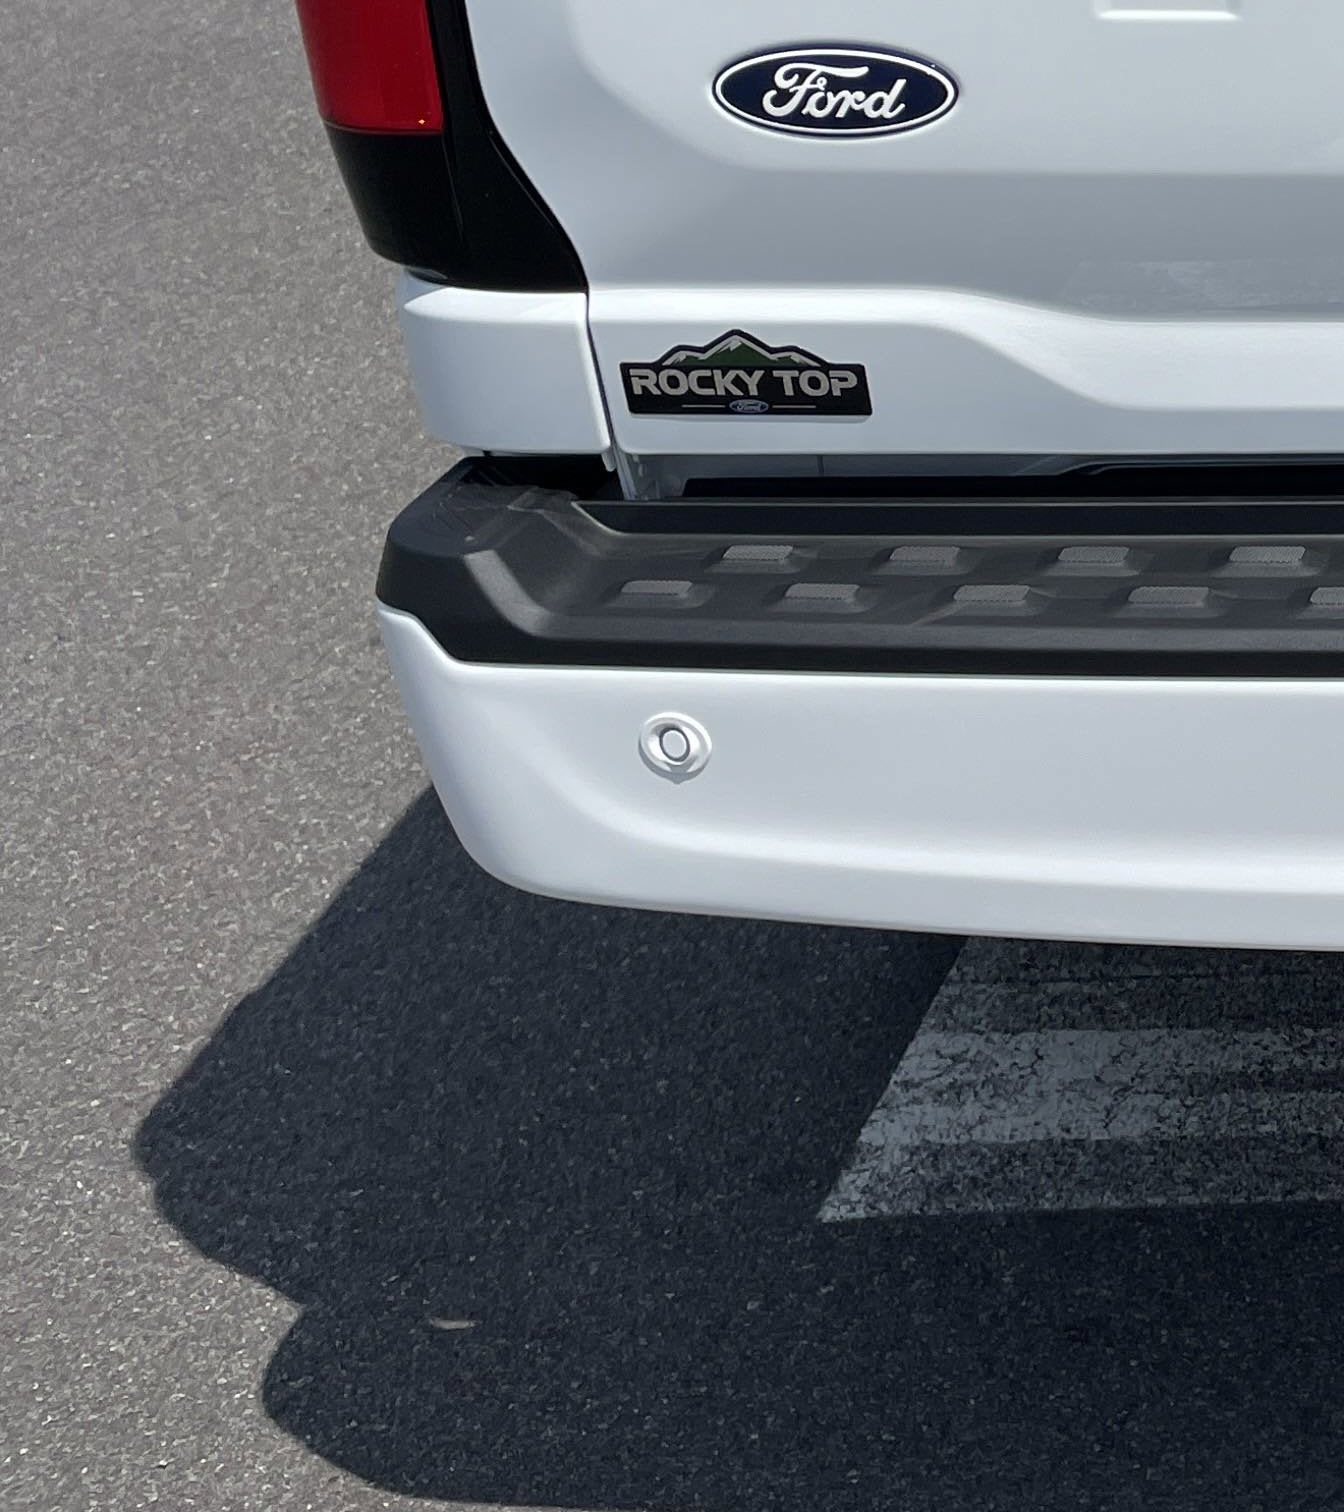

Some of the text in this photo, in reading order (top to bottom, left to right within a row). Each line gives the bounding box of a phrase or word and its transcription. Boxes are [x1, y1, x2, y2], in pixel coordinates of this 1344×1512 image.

[762, 62, 907, 118] Ford
[629, 368, 858, 397] ROCKY TOP
